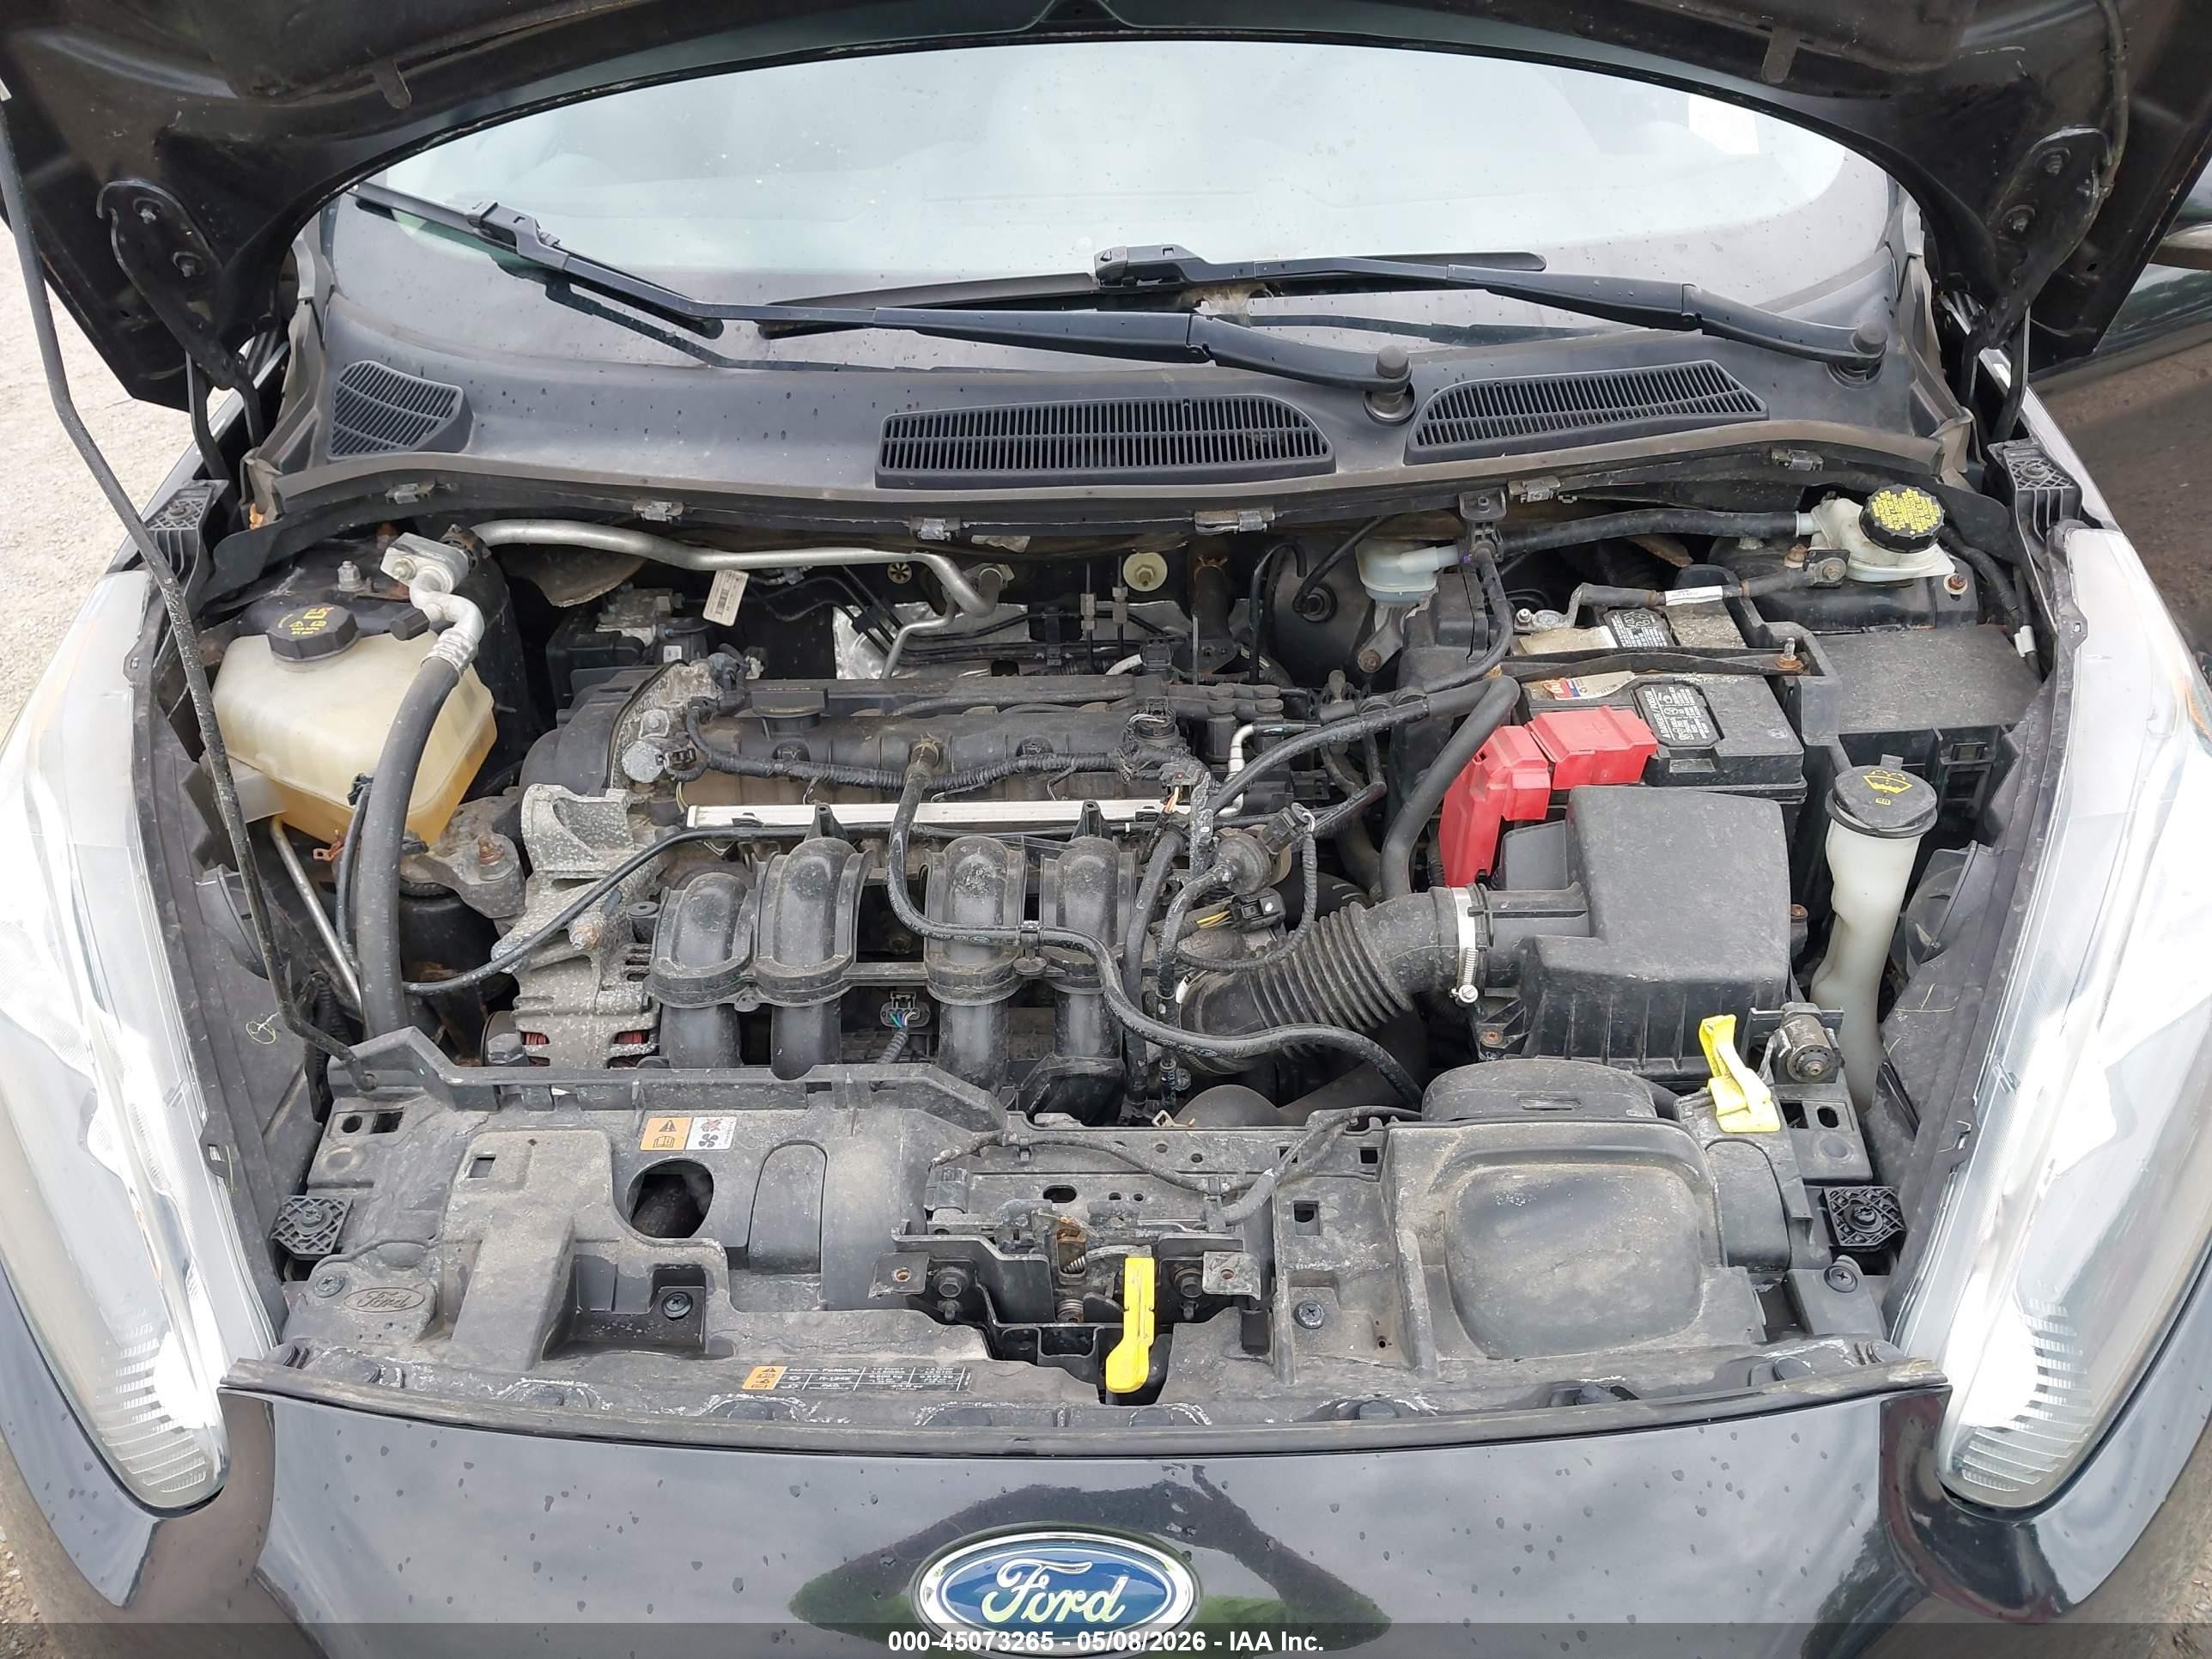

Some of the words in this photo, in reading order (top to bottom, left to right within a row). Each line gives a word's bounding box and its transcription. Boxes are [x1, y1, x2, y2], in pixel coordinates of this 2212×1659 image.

[1644, 690, 1658, 709] POISON
[1653, 714, 1668, 734] DANGER
[357, 1291, 412, 1309] Ford
[981, 1558, 1129, 1623] Ford
